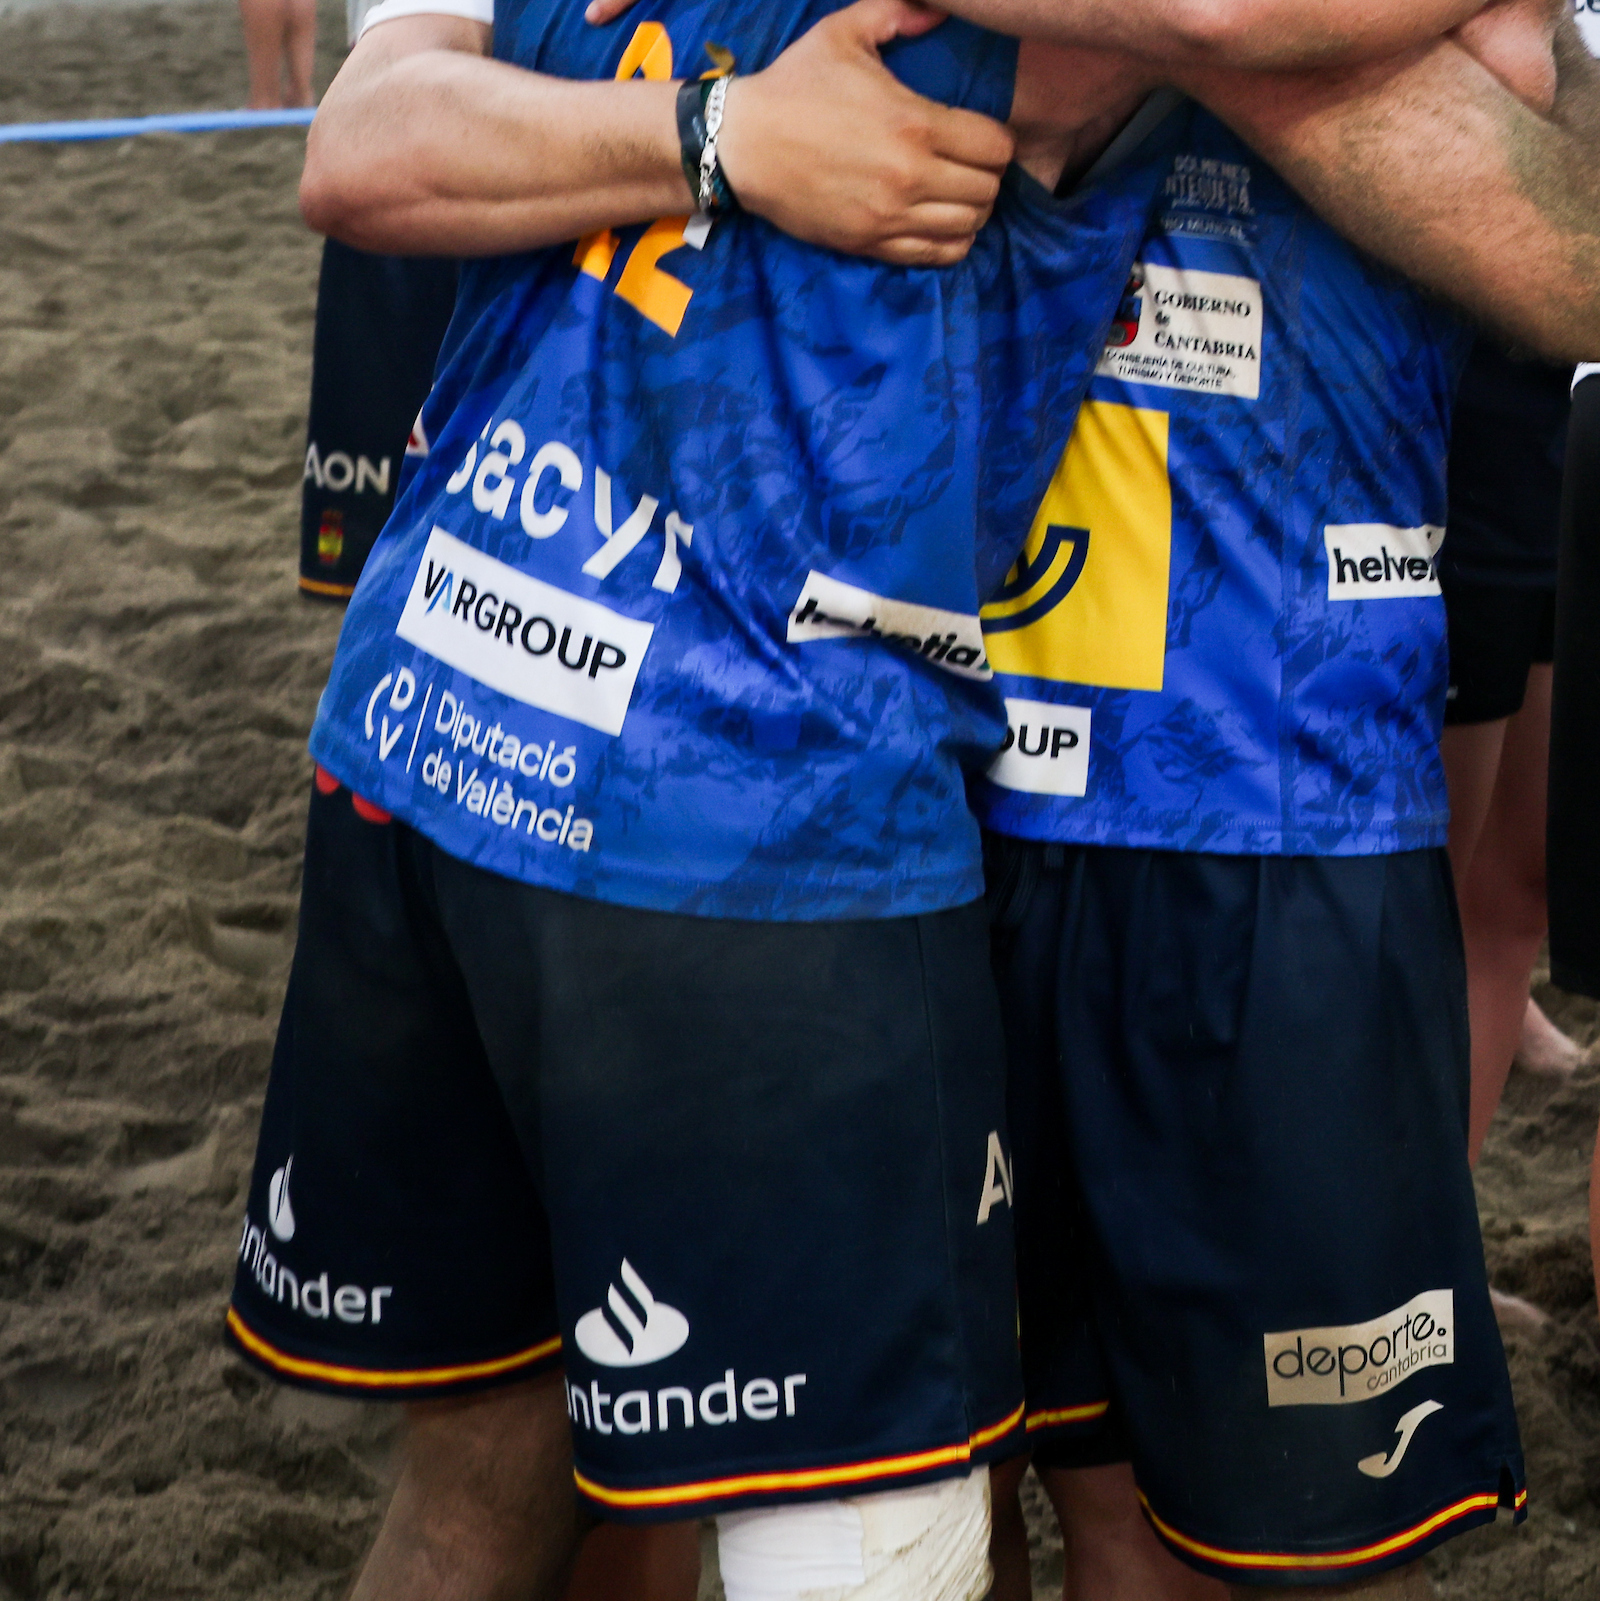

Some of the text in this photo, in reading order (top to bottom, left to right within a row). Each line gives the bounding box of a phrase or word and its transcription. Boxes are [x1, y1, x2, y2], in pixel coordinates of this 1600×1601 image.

[1154, 331, 1257, 361] CANTABRIA
[1332, 546, 1438, 585] helve
[423, 559, 628, 682] VARGROUP
[434, 689, 577, 788] Diputació
[421, 747, 453, 794] de
[239, 1214, 394, 1326] ntander
[1366, 1342, 1448, 1392] cantabria
[564, 1367, 807, 1436] ntander
